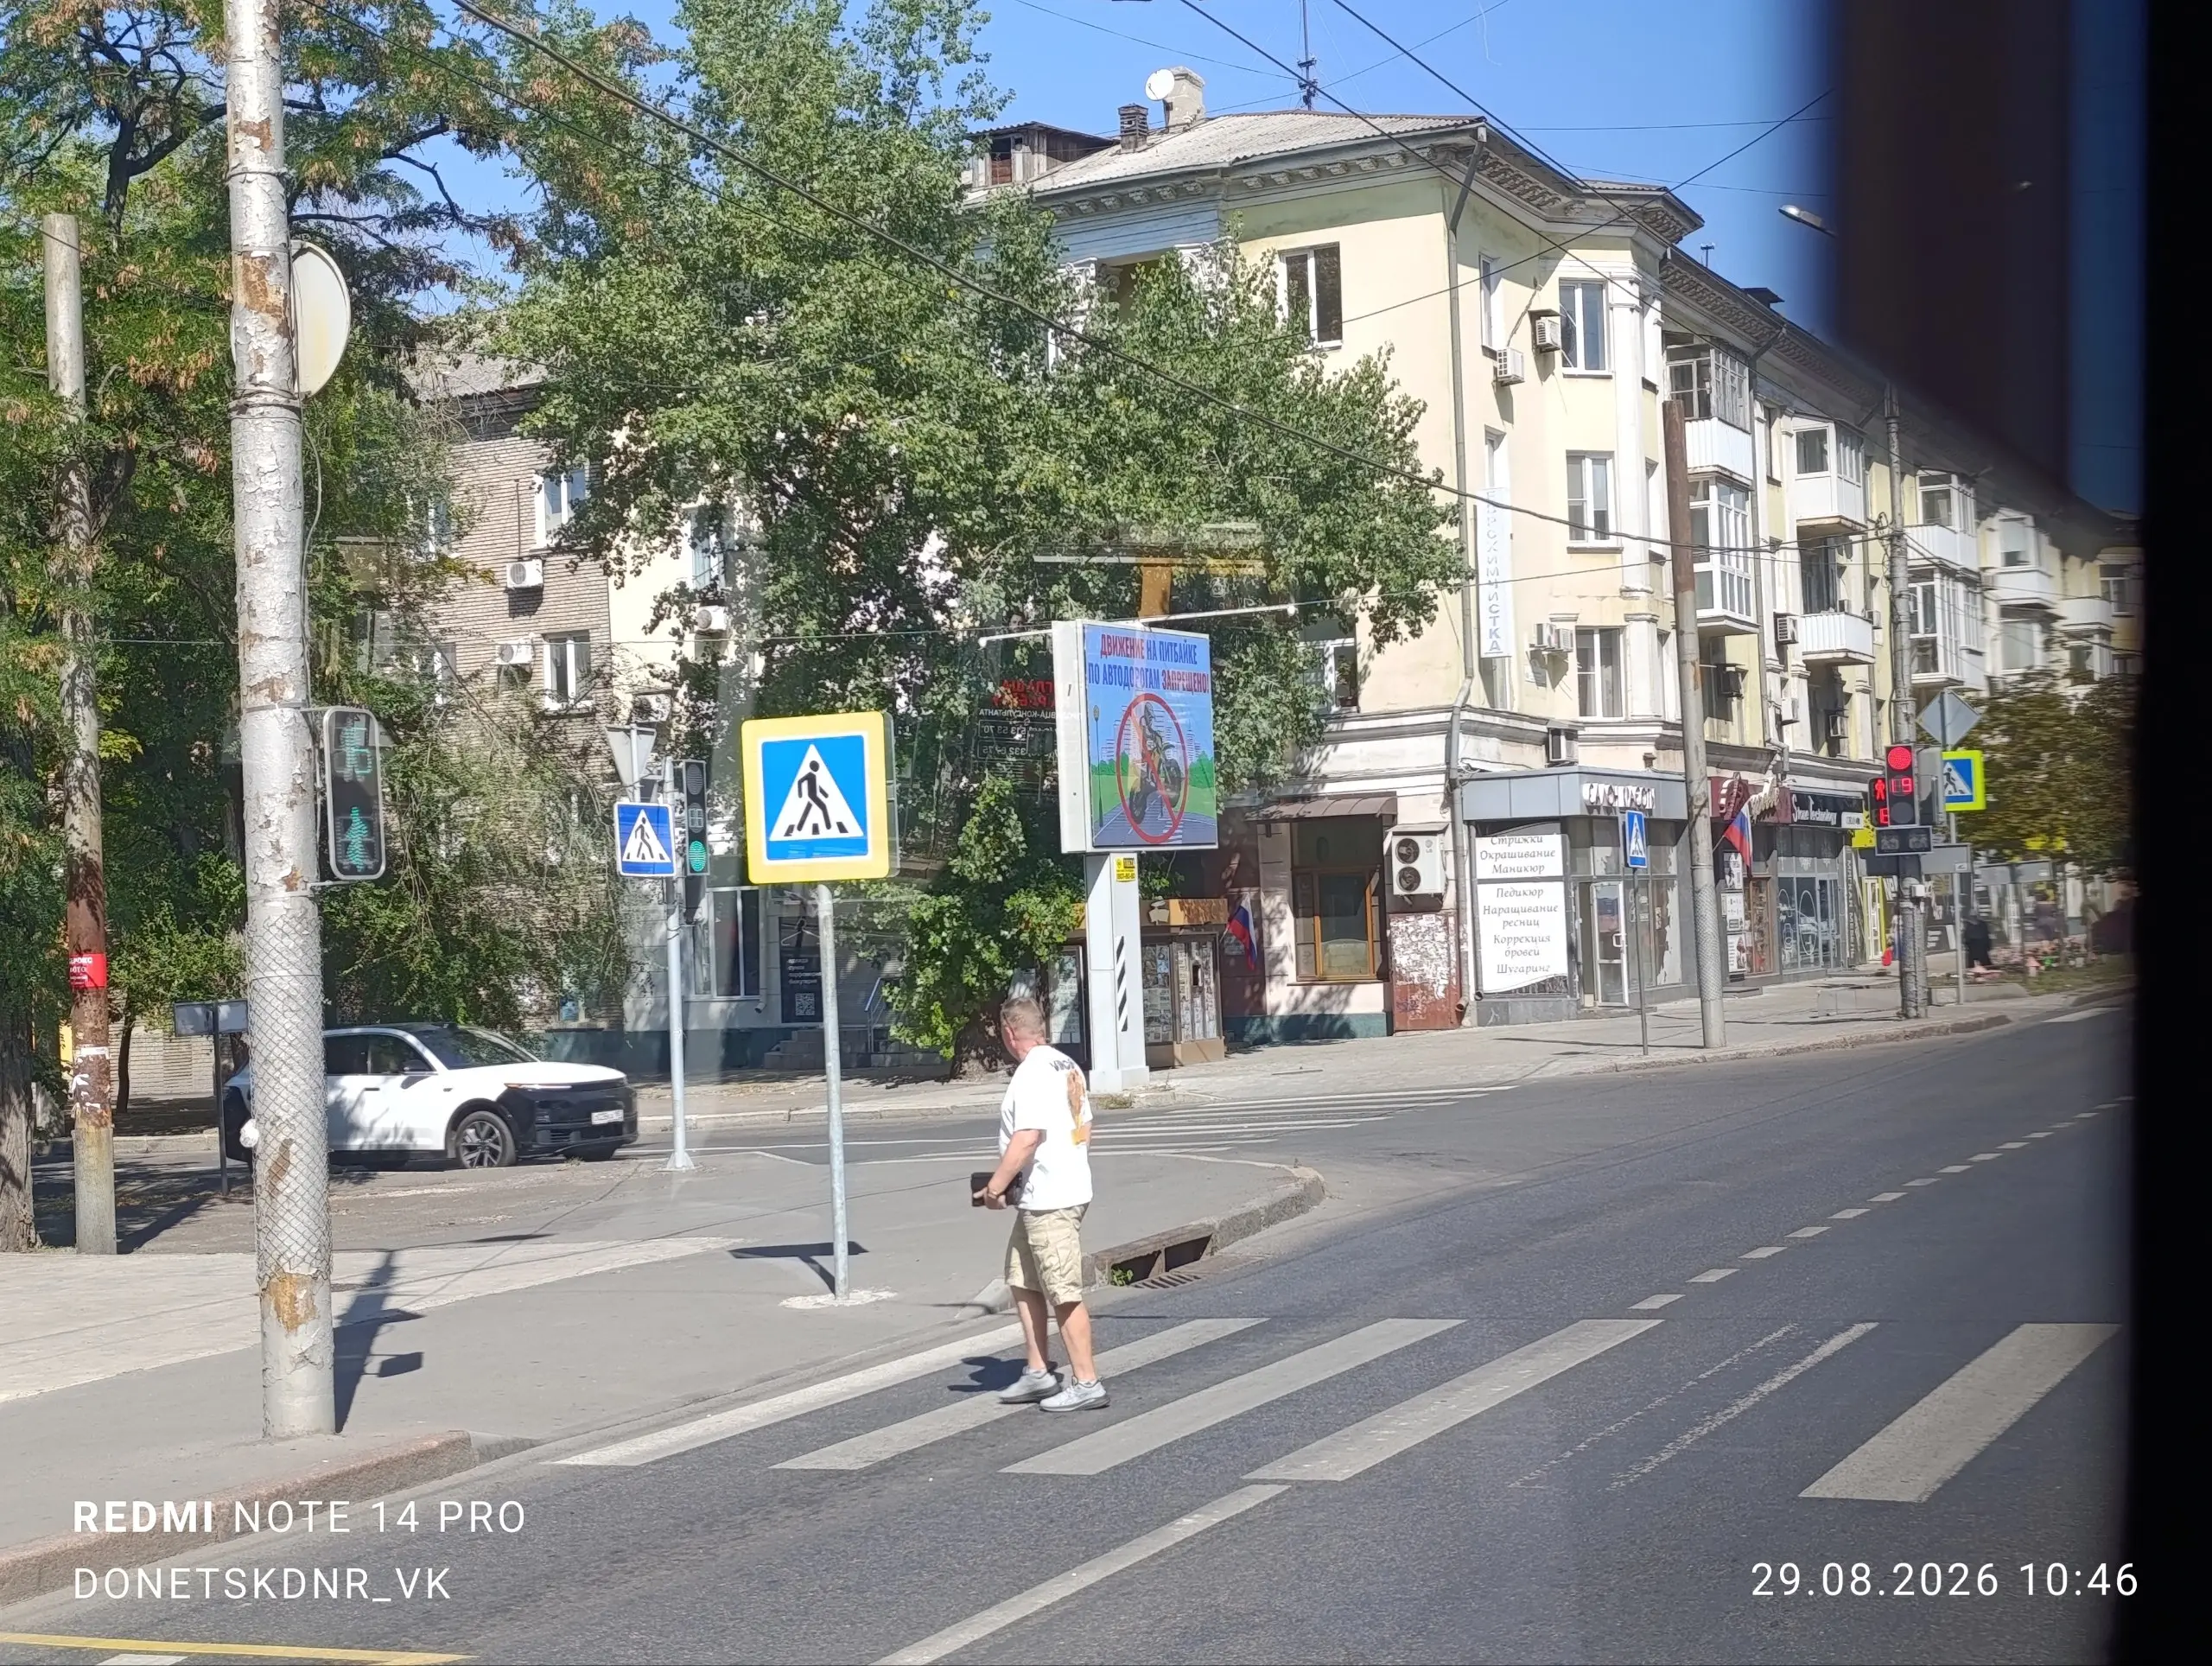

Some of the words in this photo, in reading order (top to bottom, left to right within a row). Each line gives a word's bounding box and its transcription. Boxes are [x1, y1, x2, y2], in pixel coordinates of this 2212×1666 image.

[1101, 634, 1145, 659] ДВИЖЕНИЕ
[1147, 639, 1158, 661] НА
[1159, 639, 1198, 664] ПИТБАЙКЕ
[1089, 663, 1100, 684] ПО
[1103, 664, 1160, 690] АВТОДОРОГАМ
[1161, 669, 1210, 696] ЗАПРЕЩЕНО!
[1491, 835, 1543, 847] Стрижки
[1480, 850, 1555, 864] Окрашивание
[1491, 863, 1545, 874] Маникюр
[1497, 887, 1543, 899] Педикюр
[1483, 905, 1558, 916] Наращивание
[1503, 919, 1540, 930] ресниц
[1493, 934, 1550, 946] Коррекция
[1497, 963, 1550, 975] Шугаринг
